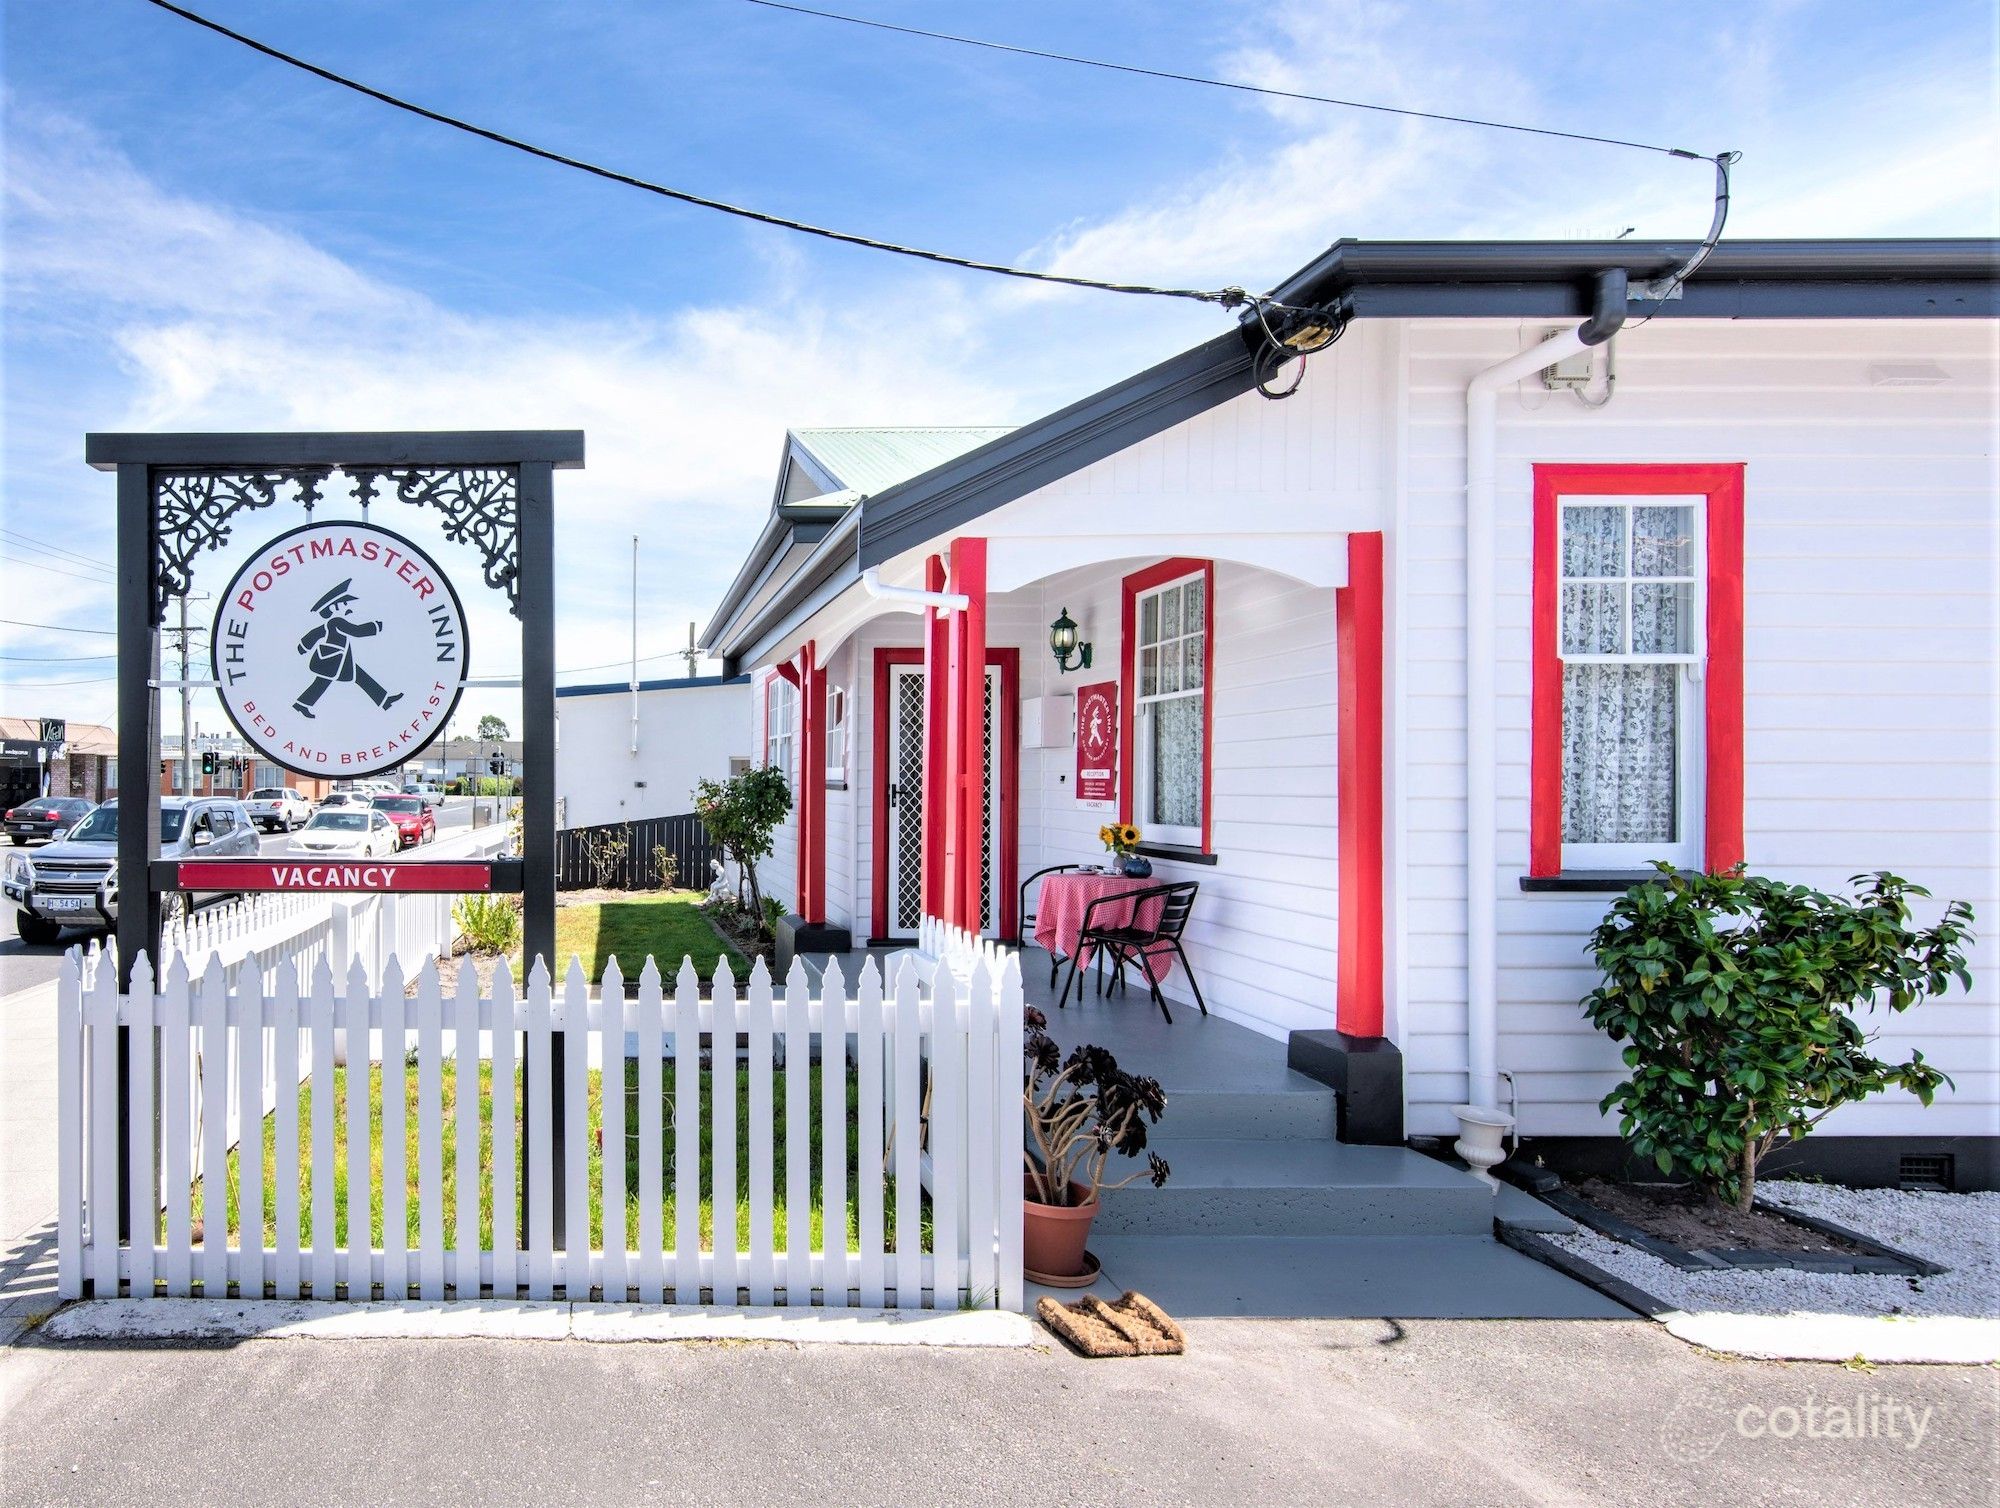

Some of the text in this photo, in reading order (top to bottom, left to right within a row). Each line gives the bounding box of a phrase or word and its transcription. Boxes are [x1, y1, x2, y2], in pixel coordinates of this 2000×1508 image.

[225, 537, 456, 686] THE POSTMASTER INN
[243, 681, 446, 764] BED AND BREAKFAST
[271, 866, 397, 887] VACANCY
